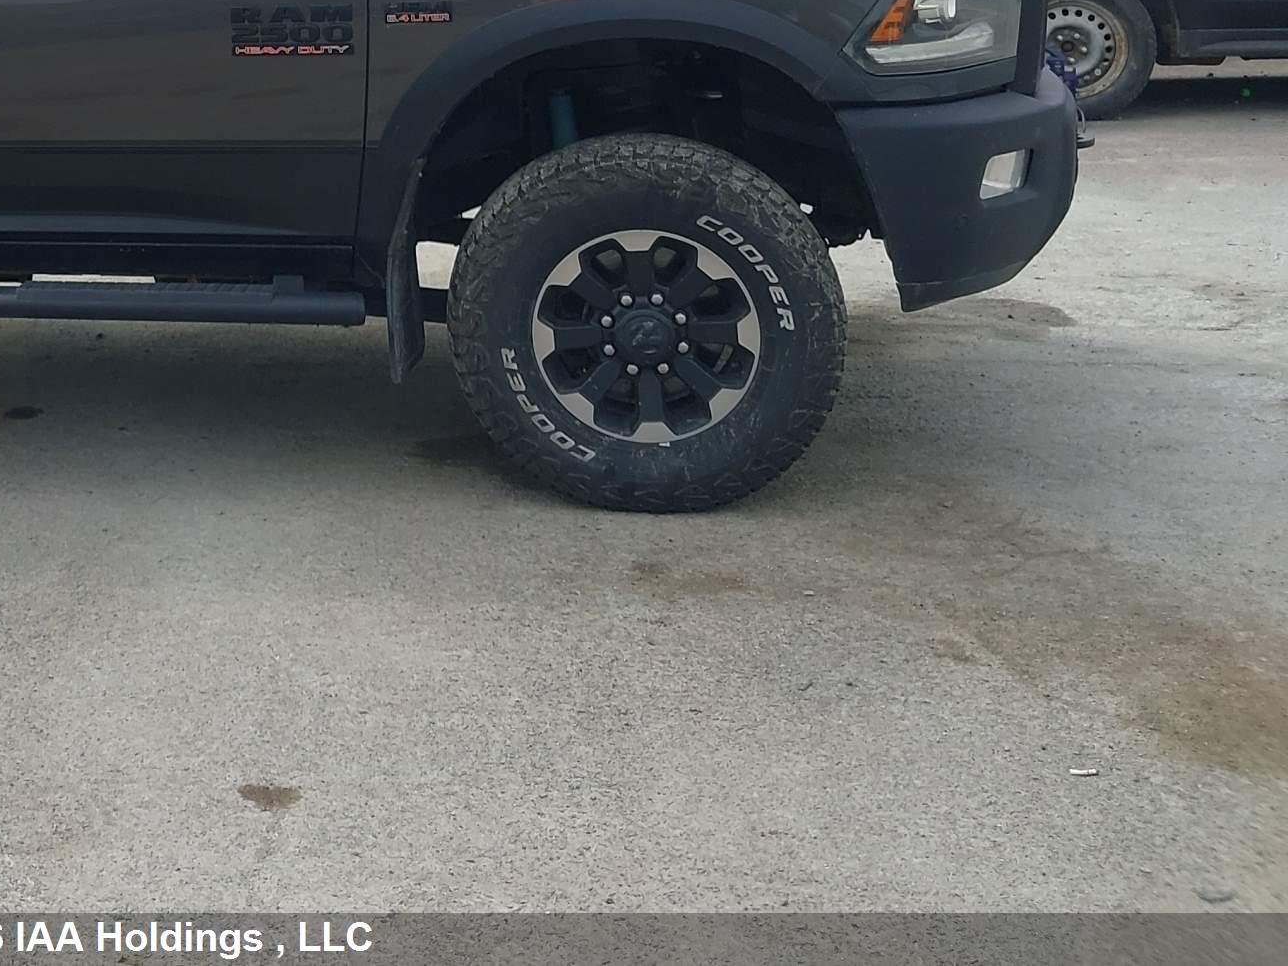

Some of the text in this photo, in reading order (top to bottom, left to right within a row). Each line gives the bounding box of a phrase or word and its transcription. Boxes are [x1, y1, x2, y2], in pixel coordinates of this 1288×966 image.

[231, 4, 353, 23] RAM
[410, 12, 450, 22] LITER
[231, 24, 354, 44] 2500
[234, 44, 351, 56] HEAVY DUTY
[695, 214, 795, 332] COOPER
[500, 346, 597, 463] COOPER
